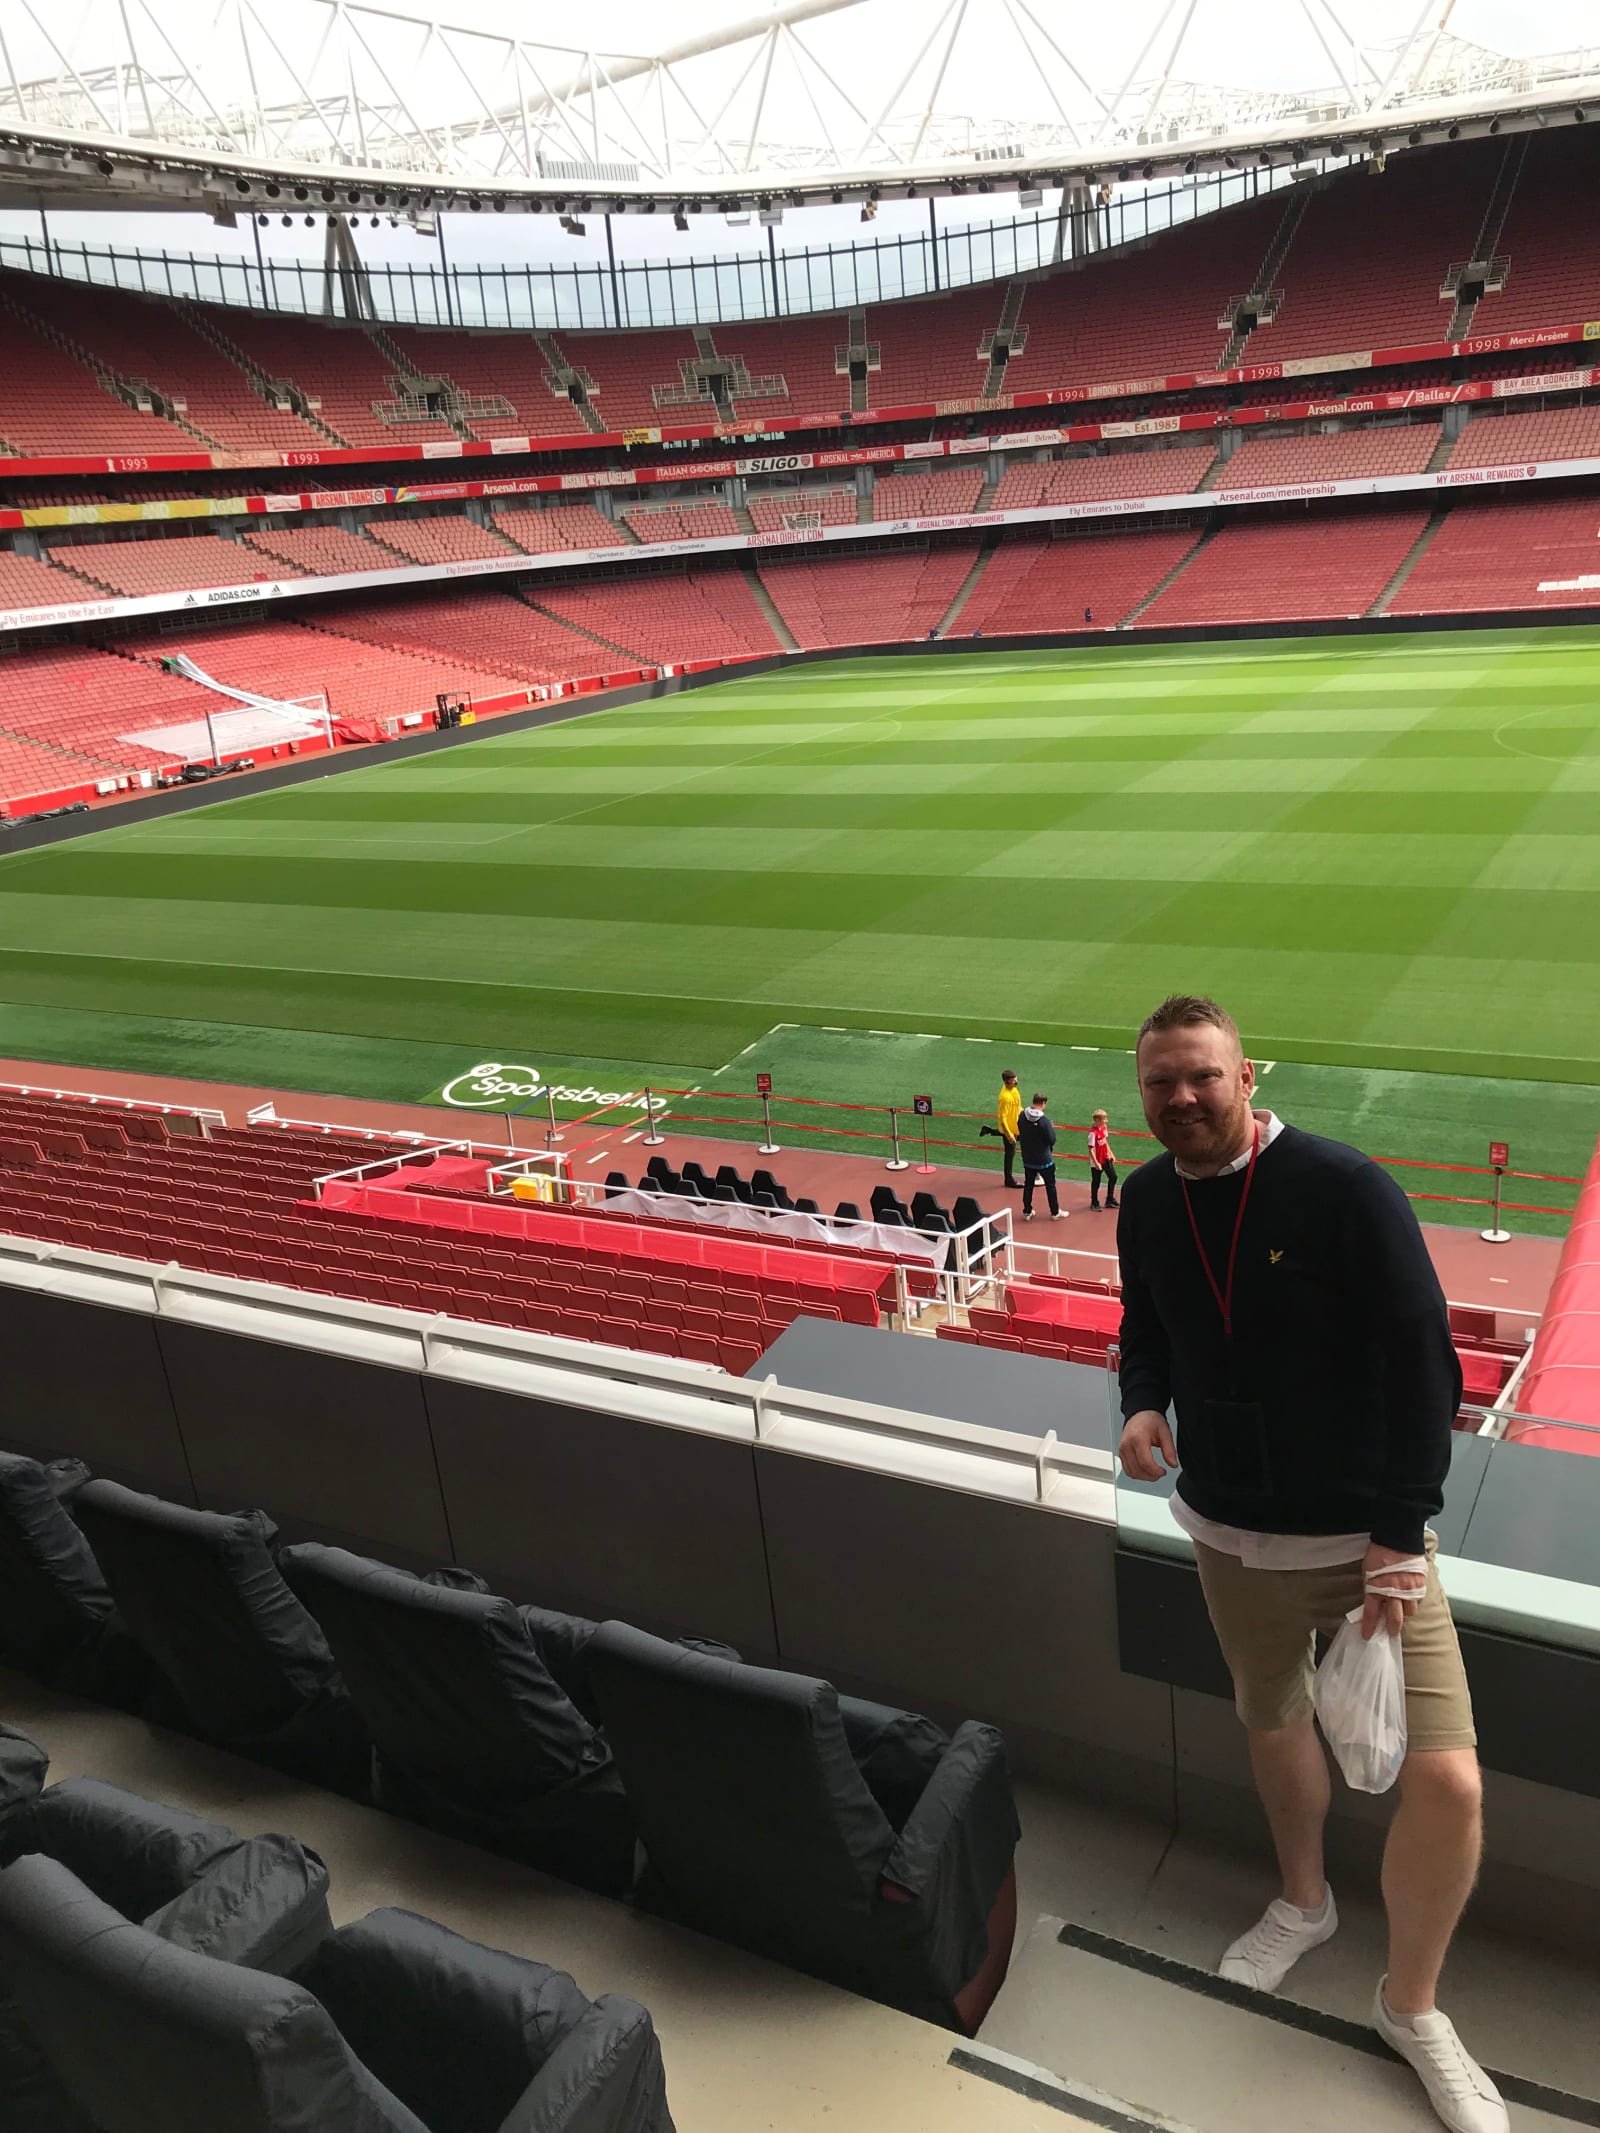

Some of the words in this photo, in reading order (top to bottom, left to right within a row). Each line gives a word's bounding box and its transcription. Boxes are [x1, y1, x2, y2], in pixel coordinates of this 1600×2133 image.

[1467, 339, 1501, 353] 1998
[1509, 333, 1535, 346] Merci
[1536, 331, 1569, 343] Arsène
[1252, 366, 1281, 379] 1998
[1504, 380, 1519, 389] BAY
[1520, 377, 1541, 387] AREA
[1543, 373, 1580, 385] GOONERS
[1059, 390, 1085, 402] 1994
[1088, 383, 1125, 398] LONDON'S
[1126, 381, 1153, 394] FINEST
[943, 400, 972, 416] ARSENAL
[974, 395, 1009, 412] MALAYSIA
[1308, 401, 1374, 417] Arsenal.com
[1135, 422, 1153, 433] Est.
[1154, 419, 1178, 431] 1985
[120, 458, 149, 471] 1993
[292, 453, 320, 465] 1993
[750, 457, 799, 472] SLIGO
[820, 453, 849, 465] ARSENAL
[866, 449, 896, 460] AMERICA
[656, 465, 688, 477] ITALIAN
[690, 463, 732, 474] GOONERS
[1436, 475, 1448, 486] MY
[1450, 472, 1484, 484] ARSENAL
[1486, 468, 1525, 481] REWARDS
[483, 481, 538, 495] Arsenal.com
[1220, 484, 1337, 502] Arsenal.com/membership
[315, 493, 347, 507] ARSENAL
[347, 490, 375, 505] FRANCE
[1069, 507, 1081, 516] Fly
[1082, 504, 1113, 514] Emirates
[1123, 501, 1146, 511] Dubai
[747, 530, 824, 547] ARSENALDIRECT.COM
[446, 567, 456, 576] Fly
[457, 564, 484, 574] Emirates
[495, 559, 533, 570] Australasia
[208, 588, 261, 602] ADIDAS.COM
[4, 615, 18, 627] Fly
[20, 611, 56, 624] Emirates
[68, 608, 81, 617] the
[83, 606, 97, 617] Far
[98, 605, 115, 615] East
